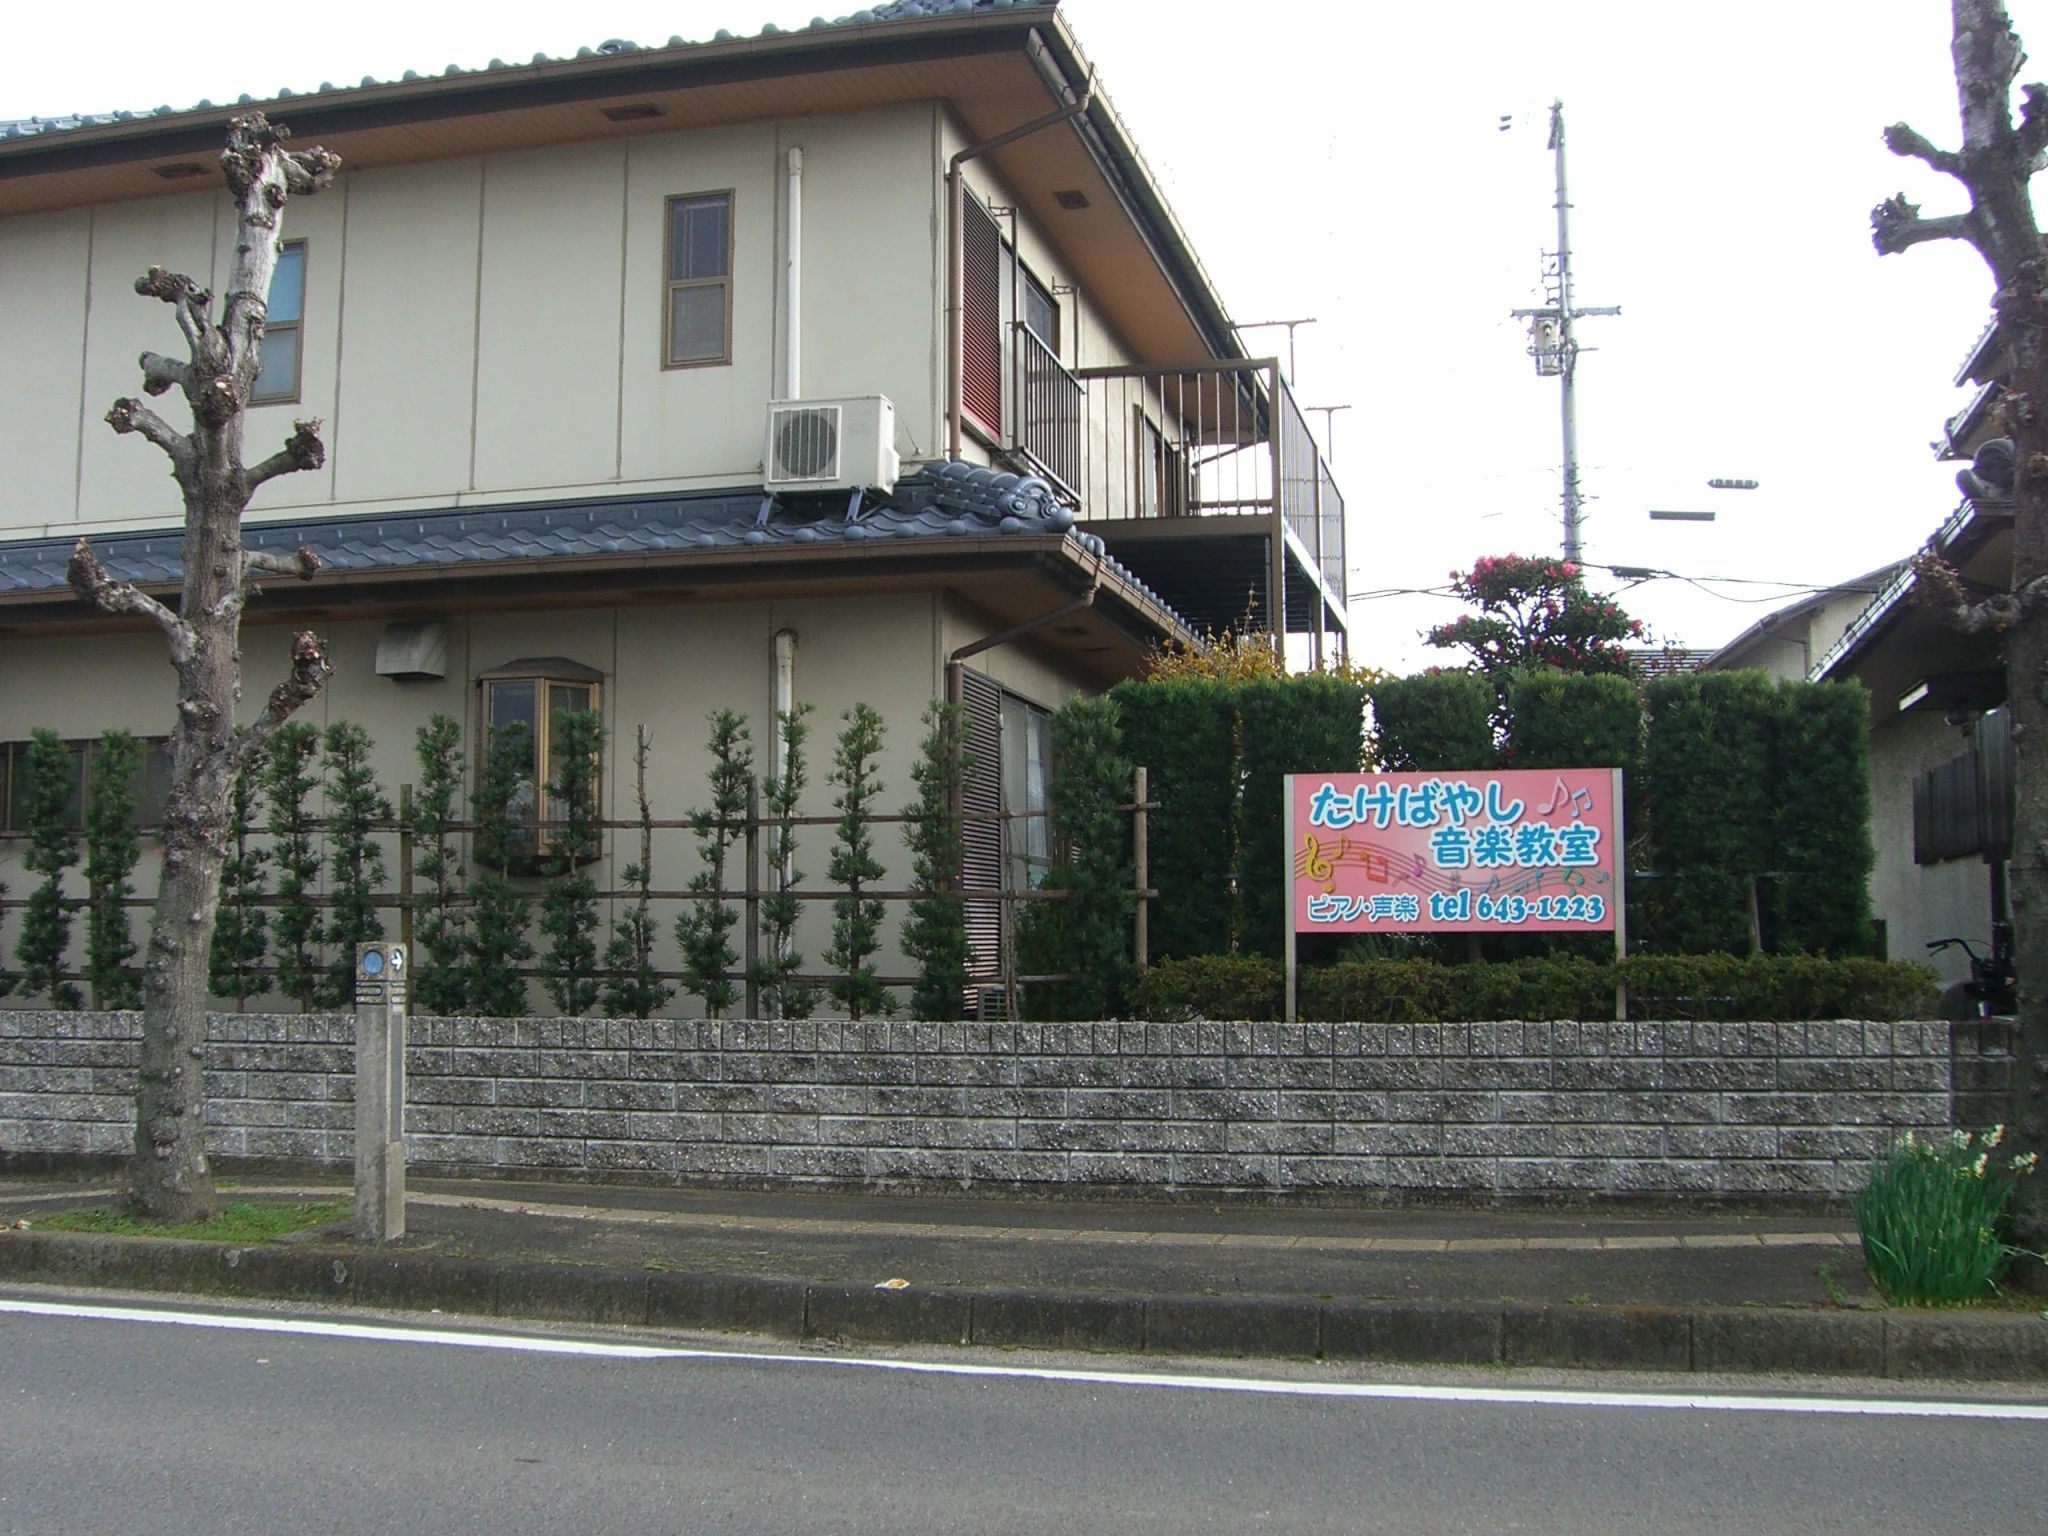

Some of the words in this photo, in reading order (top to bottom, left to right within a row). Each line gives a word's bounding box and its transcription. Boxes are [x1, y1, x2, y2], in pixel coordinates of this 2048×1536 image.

[1311, 780, 1523, 826] たけばやし
[1431, 823, 1598, 867] 音楽教室
[1308, 894, 1419, 921] ピアノ・声楽
[1430, 889, 1470, 921] tel
[1477, 895, 1604, 923] 643-1223
